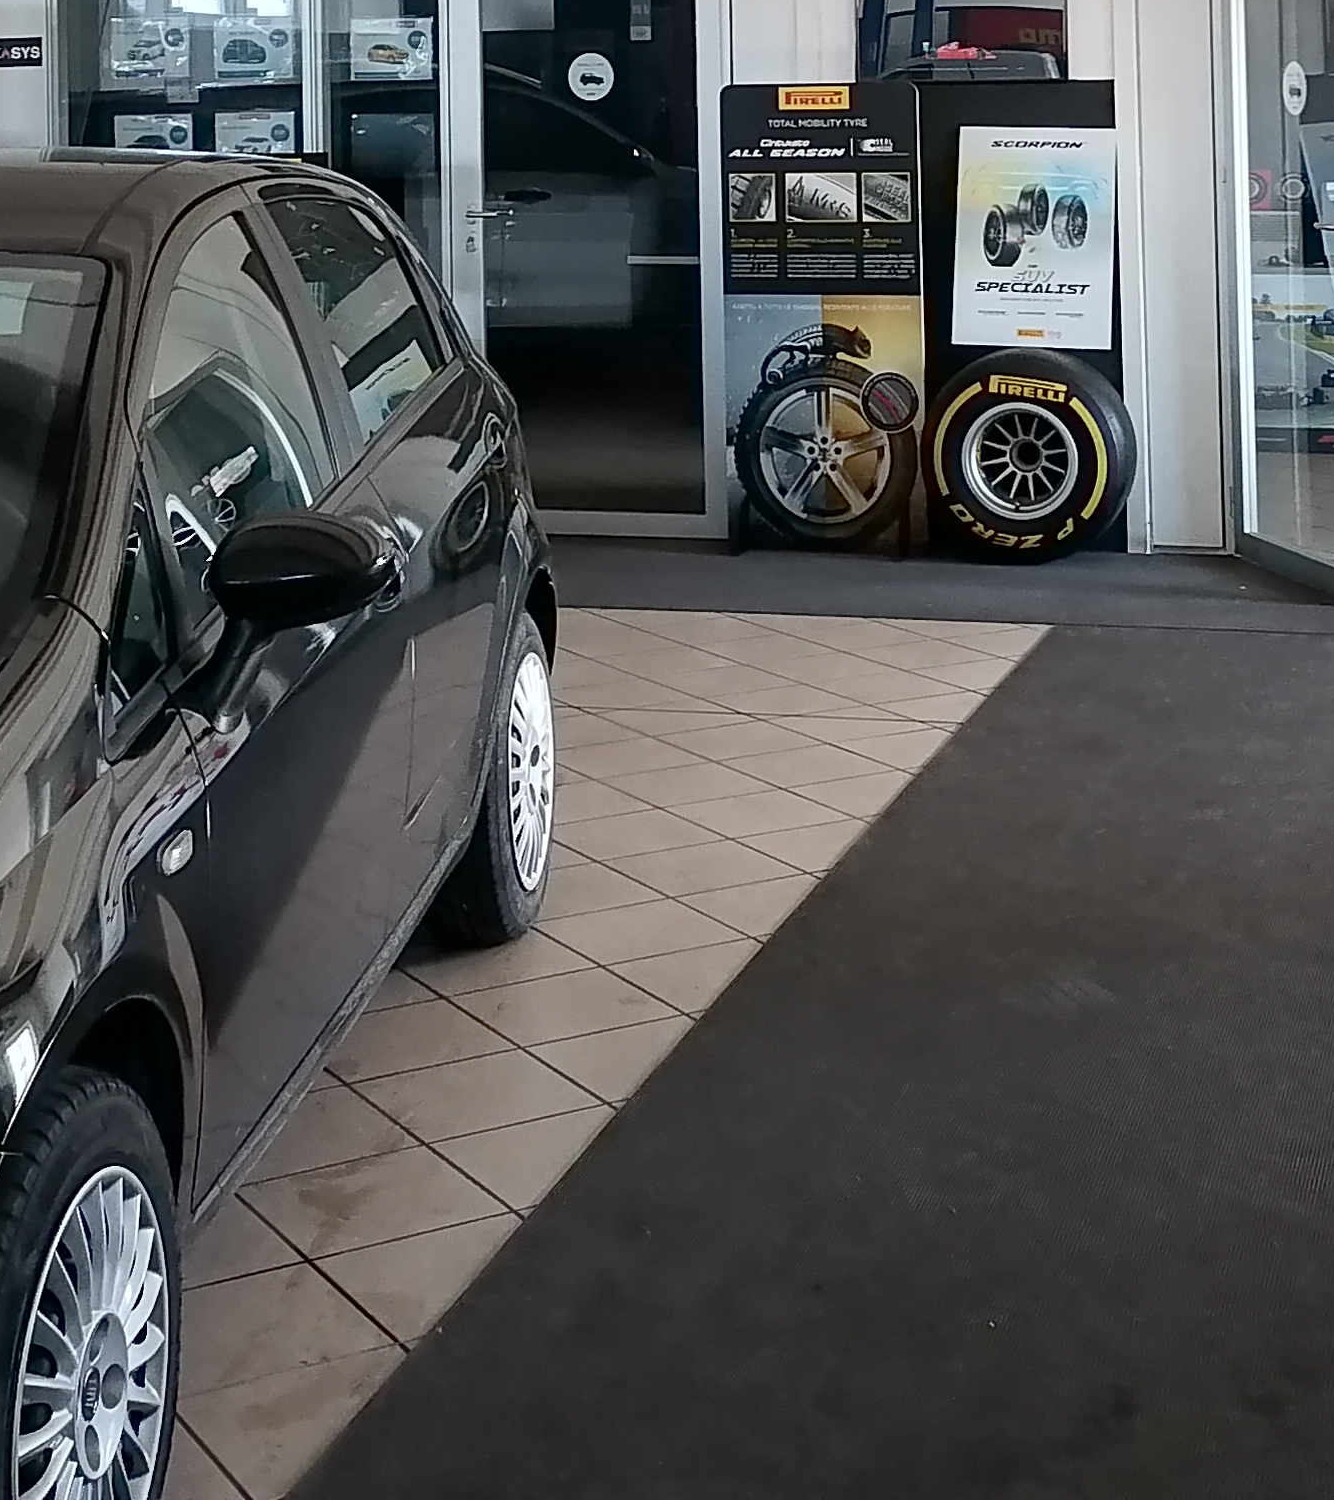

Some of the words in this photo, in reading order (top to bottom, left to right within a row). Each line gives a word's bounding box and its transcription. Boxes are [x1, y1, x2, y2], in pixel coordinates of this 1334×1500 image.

[784, 91, 843, 105] PIRELLI
[768, 119, 797, 128] TOTAL
[798, 119, 841, 128] MOBILITY
[843, 118, 868, 127] TYRE
[991, 140, 1083, 149] SCORPION
[728, 149, 764, 158] ALL
[769, 148, 846, 158] SEASON
[975, 282, 1090, 295] SPECIALIST
[989, 375, 1067, 403] PIRELLI
[949, 503, 1044, 550] ZERO
[1056, 518, 1075, 541] P
